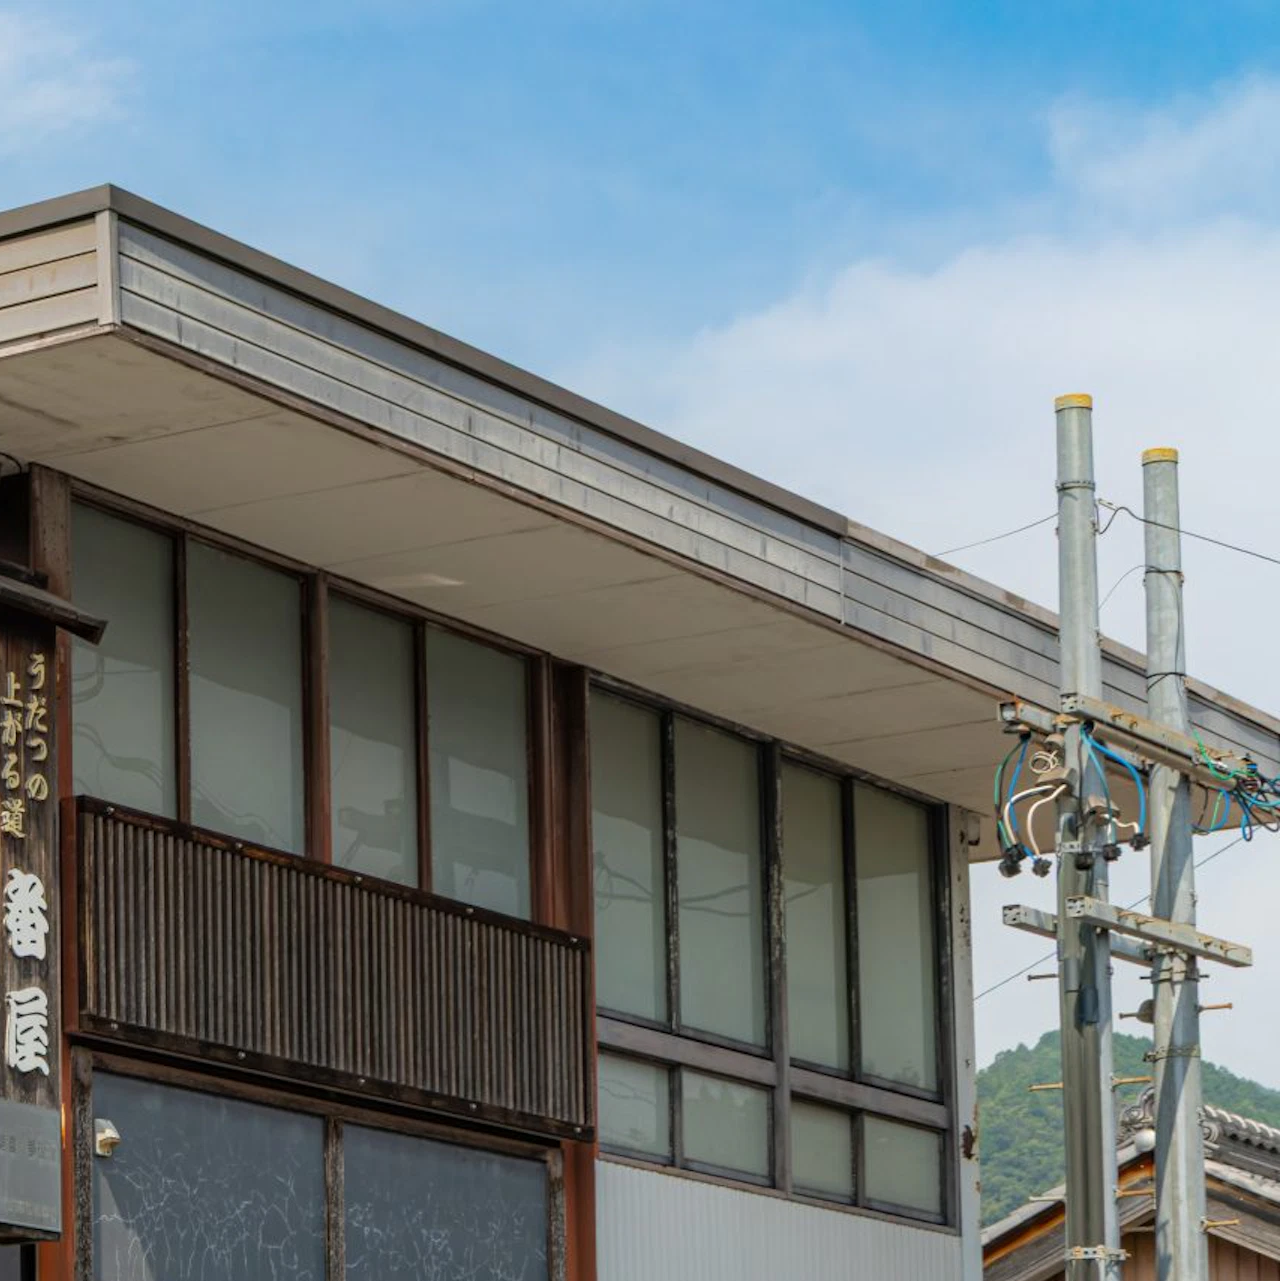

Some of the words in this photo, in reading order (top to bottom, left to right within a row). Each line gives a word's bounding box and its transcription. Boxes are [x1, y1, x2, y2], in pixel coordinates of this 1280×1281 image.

[0, 672, 26, 838] 上がる道
[24, 653, 49, 802] うだつの
[3, 867, 51, 1076] 番屋
